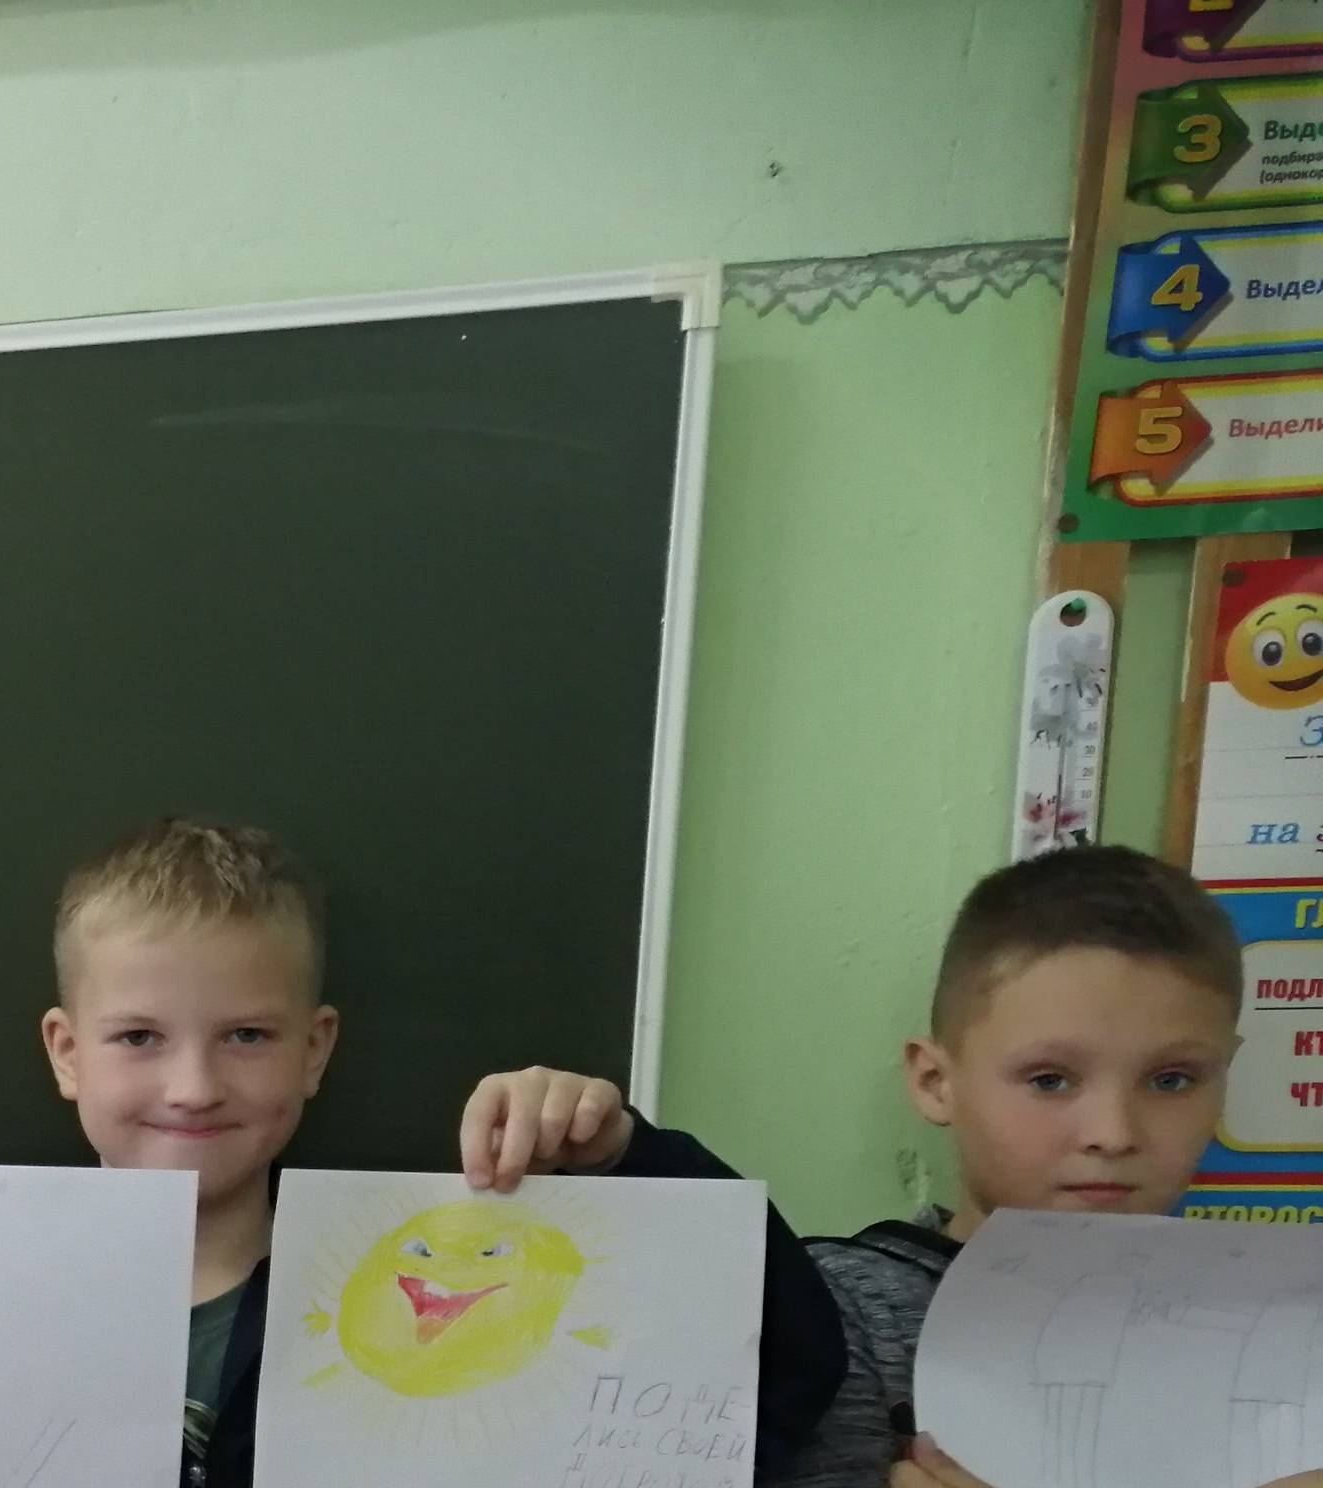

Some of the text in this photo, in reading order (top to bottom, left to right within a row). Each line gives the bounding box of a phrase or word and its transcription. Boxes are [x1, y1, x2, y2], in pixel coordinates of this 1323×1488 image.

[1173, 114, 1223, 163] 3
[1151, 264, 1204, 312] 4
[1134, 406, 1184, 455] 5
[1246, 822, 1301, 846] на
